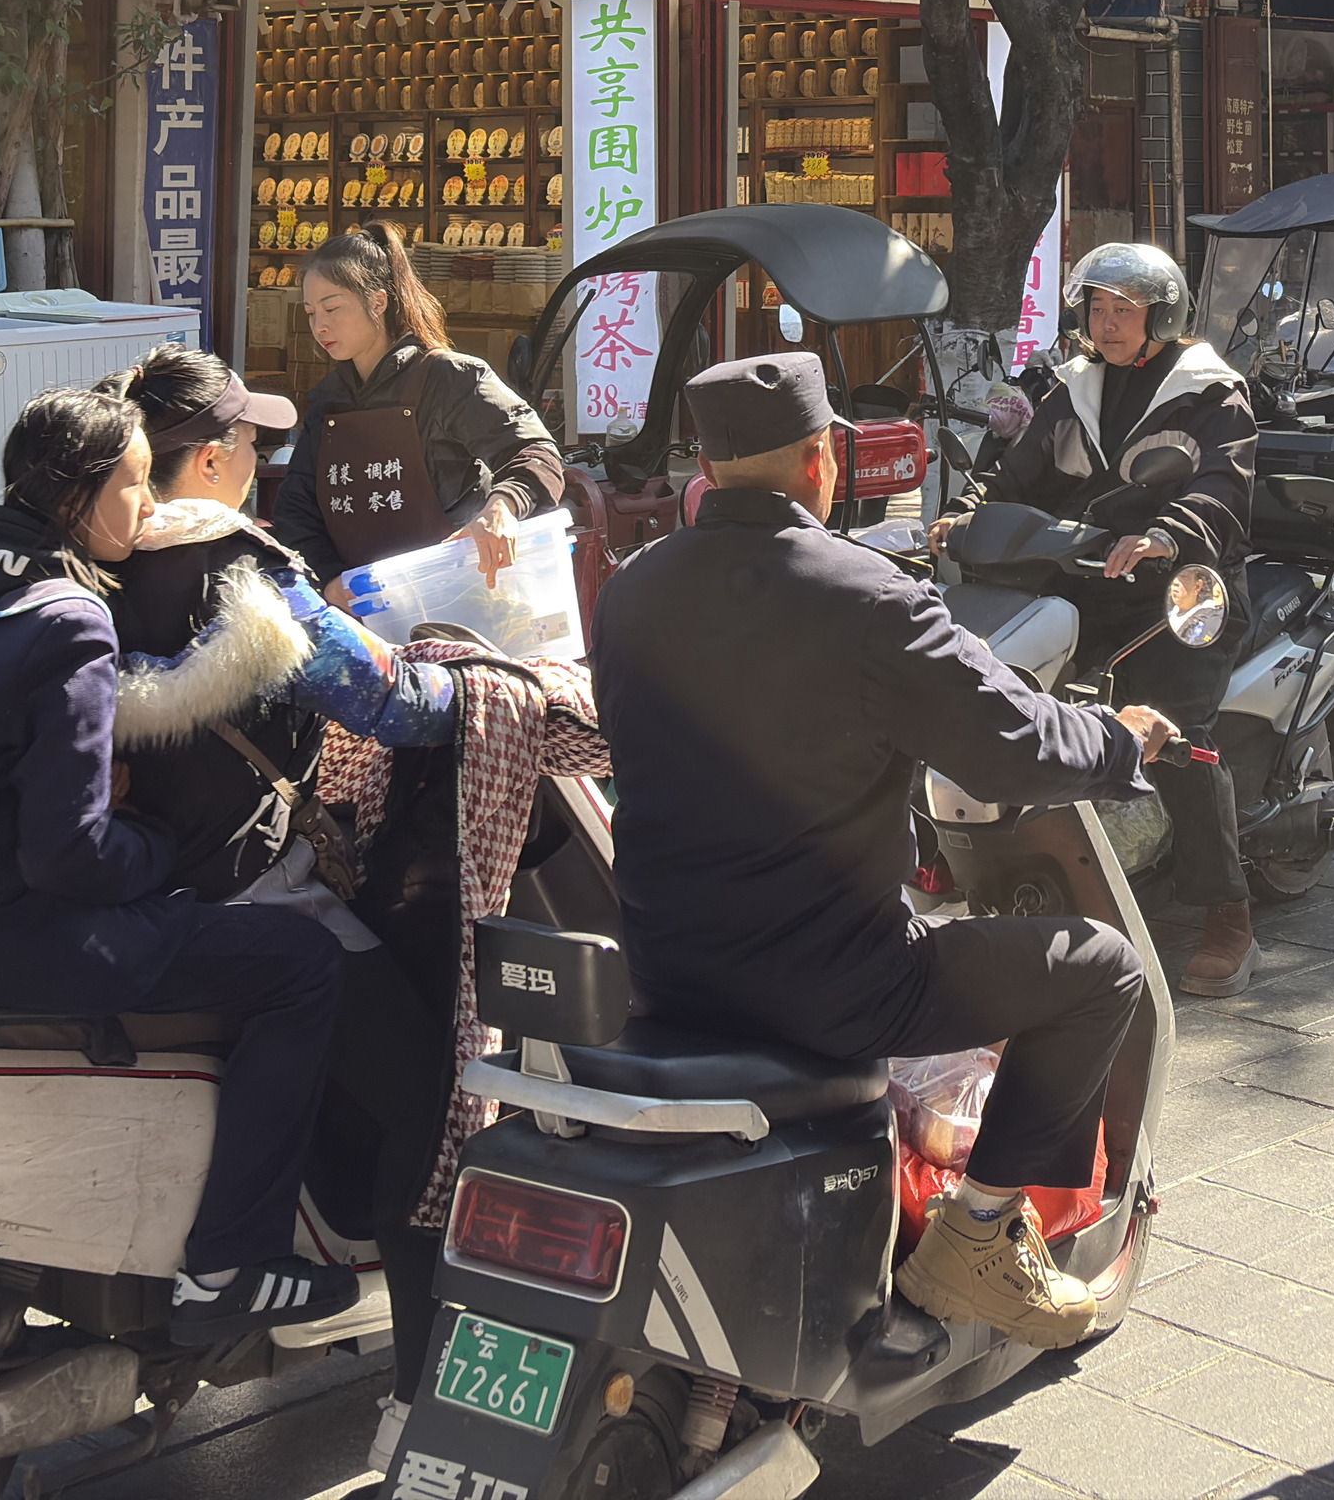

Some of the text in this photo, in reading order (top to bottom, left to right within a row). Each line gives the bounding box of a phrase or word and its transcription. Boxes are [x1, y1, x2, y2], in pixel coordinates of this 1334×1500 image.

[1225, 97, 1255, 116] 高原特产
[1226, 118, 1252, 136] 野生菌
[1226, 139, 1244, 156] 松茸
[152, 30, 206, 306] 件产品最
[364, 457, 404, 481] 调料
[329, 489, 405, 514] 批发 零售
[501, 960, 557, 996] 爱玛
[450, 1356, 551, 1423] 72661
